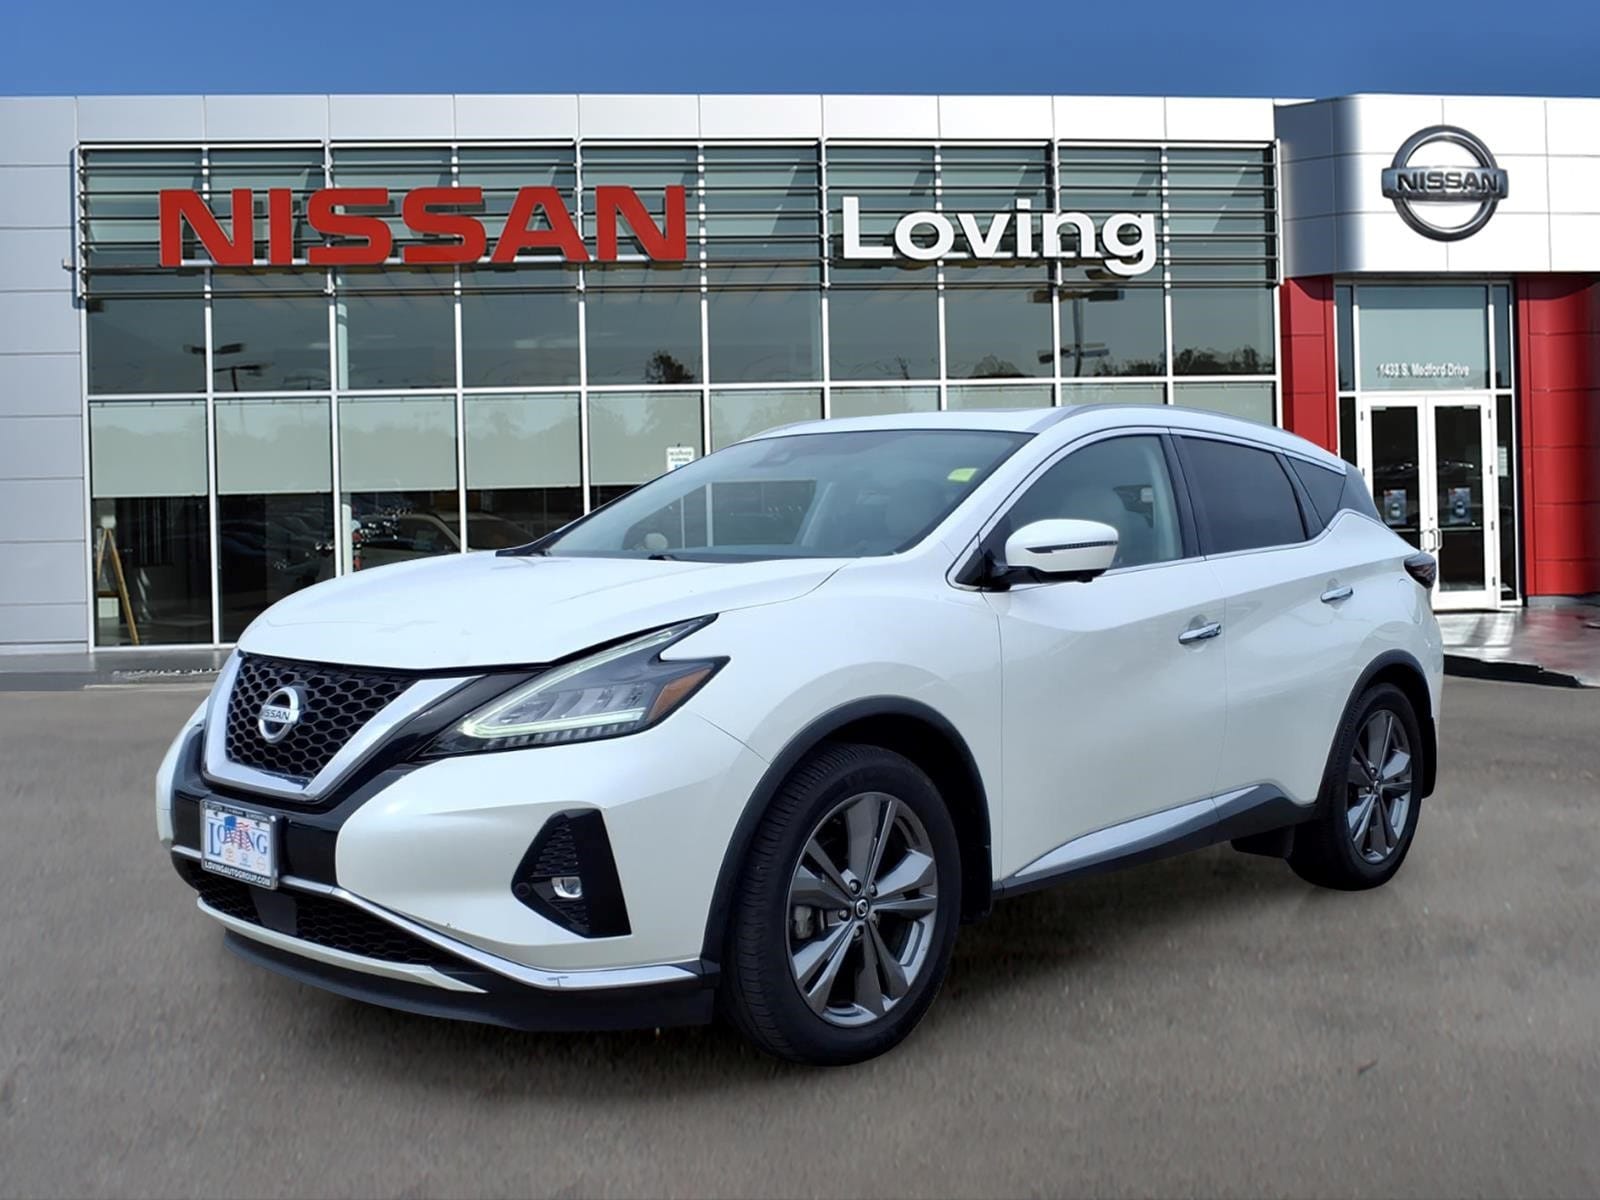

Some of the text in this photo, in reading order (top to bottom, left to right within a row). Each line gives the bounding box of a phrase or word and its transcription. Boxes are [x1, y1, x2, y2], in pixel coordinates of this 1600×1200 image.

[1397, 171, 1498, 192] NISSAN
[159, 185, 687, 266] NISSAN
[842, 196, 1157, 277] Loving
[1411, 362, 1446, 376] Medford
[1447, 362, 1470, 376] Drive
